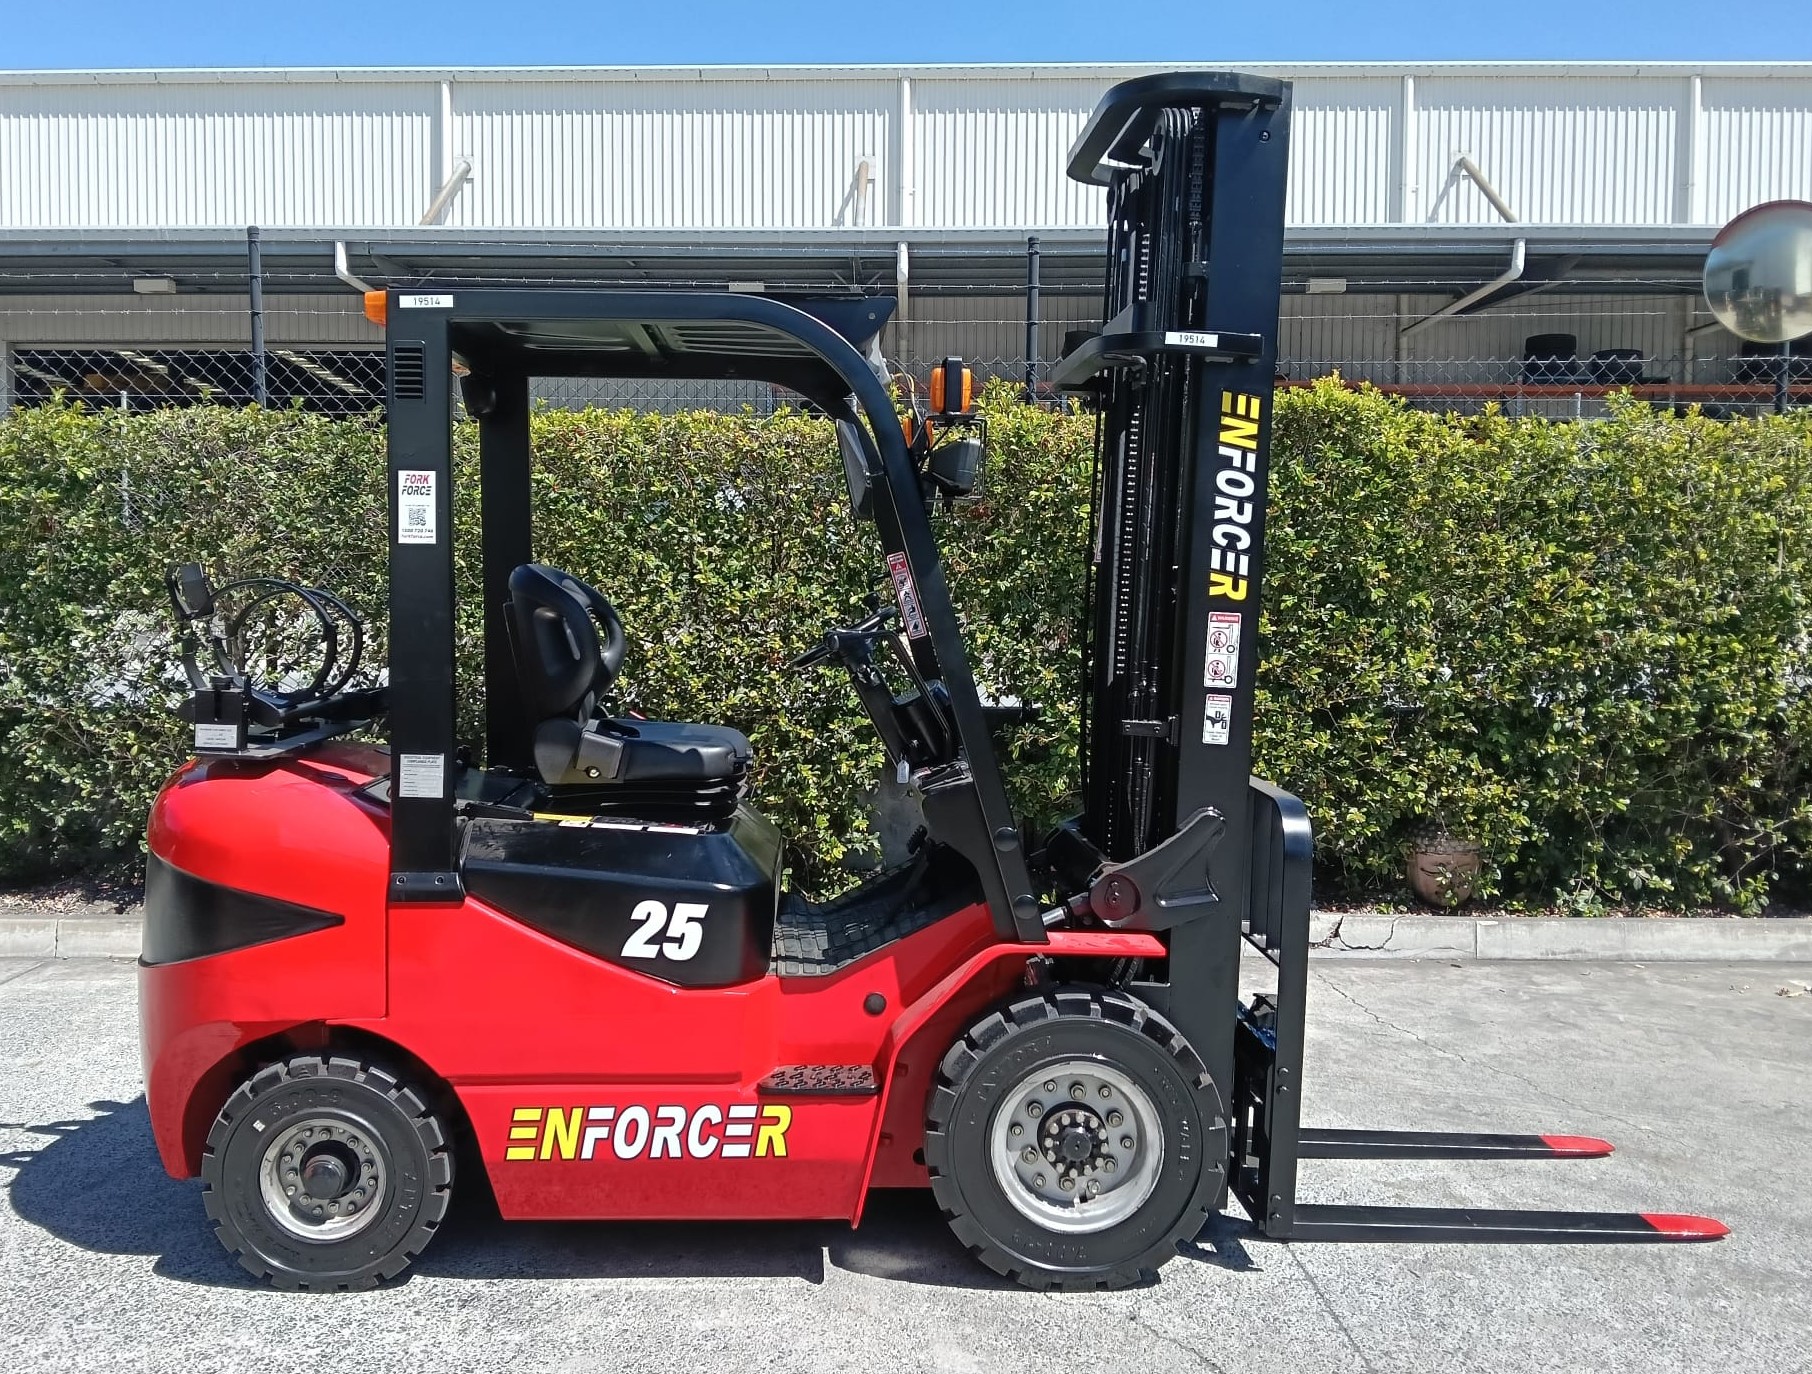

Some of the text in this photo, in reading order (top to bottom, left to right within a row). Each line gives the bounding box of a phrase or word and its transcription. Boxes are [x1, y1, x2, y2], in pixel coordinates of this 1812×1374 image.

[413, 297, 440, 306] 19514
[1179, 334, 1205, 345] 19514
[404, 474, 430, 484] FORK
[402, 485, 432, 496] FORCE
[1209, 390, 1262, 602] ENFORCER
[620, 899, 709, 961] 25
[505, 1103, 793, 1161] ENFORCER
